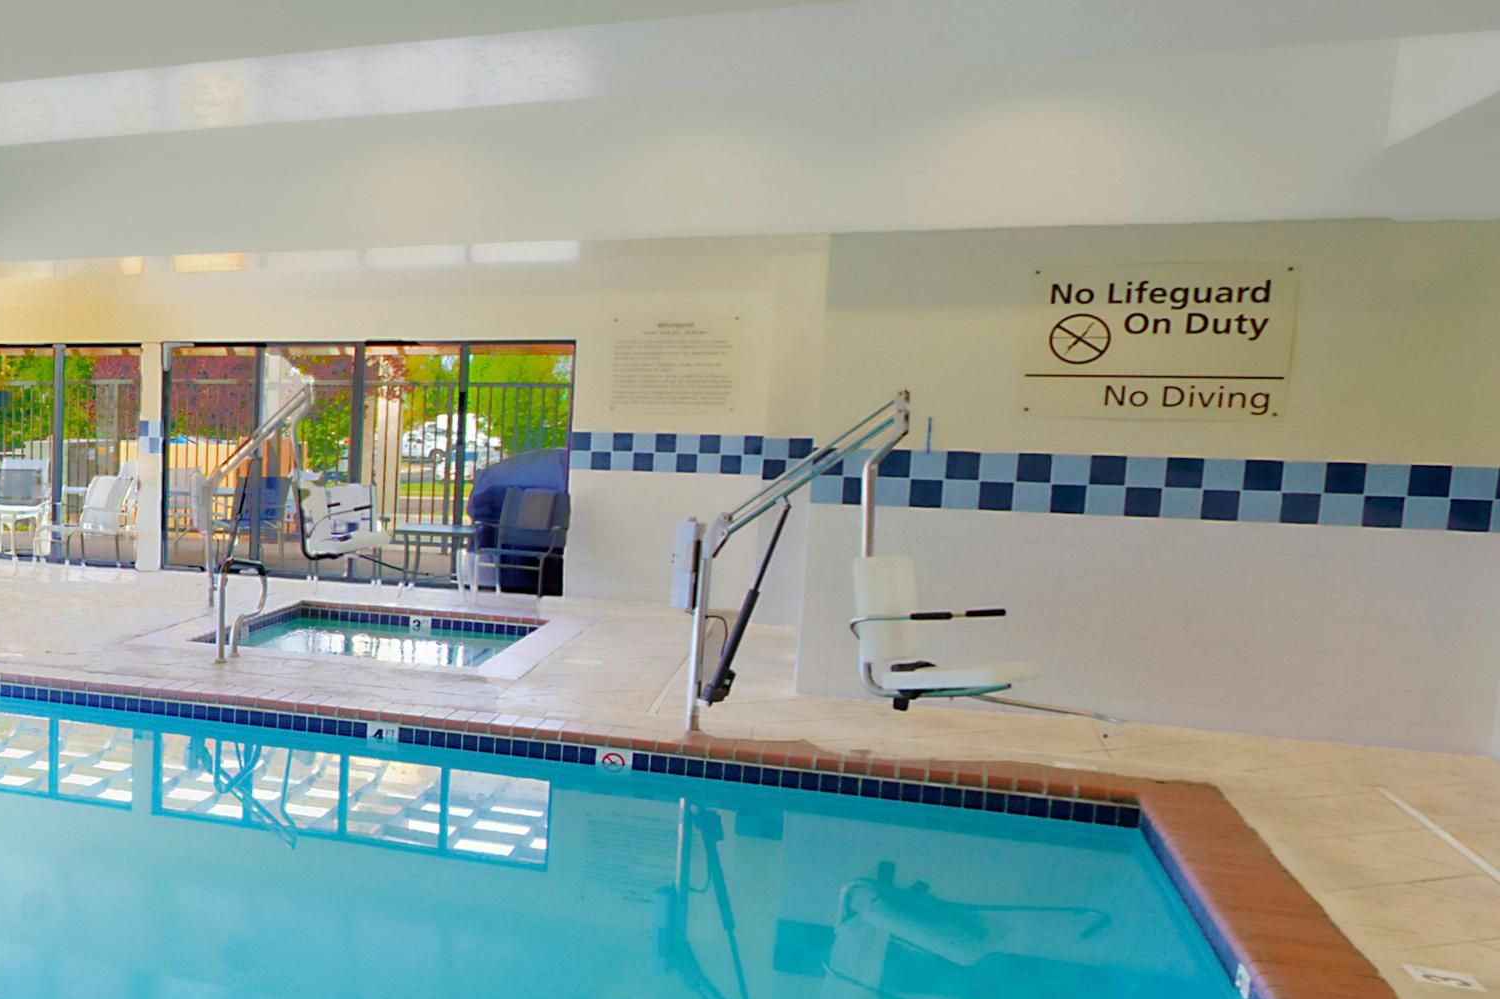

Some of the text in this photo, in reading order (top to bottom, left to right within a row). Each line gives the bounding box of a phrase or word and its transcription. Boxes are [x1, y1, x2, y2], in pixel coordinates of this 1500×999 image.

[1050, 279, 1272, 310] No Lifeguard
[1124, 312, 1269, 341] On Duty
[1104, 385, 1271, 416] No Diving
